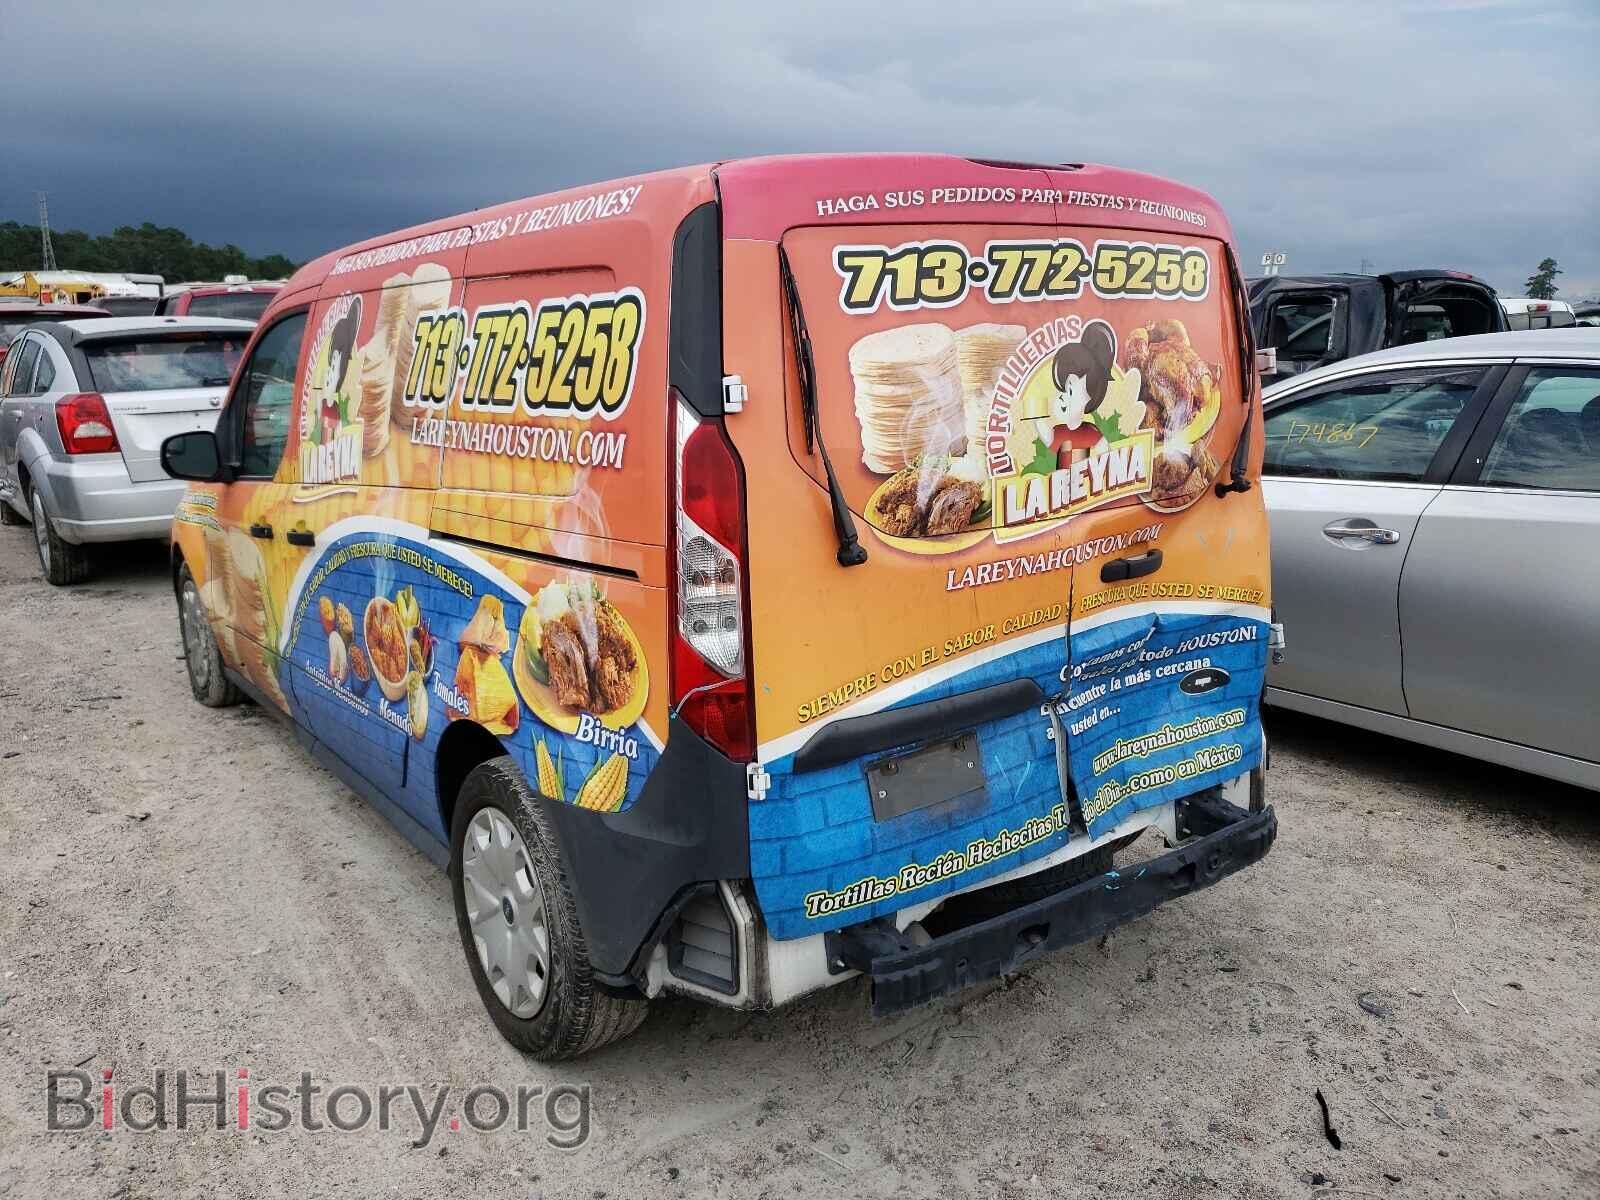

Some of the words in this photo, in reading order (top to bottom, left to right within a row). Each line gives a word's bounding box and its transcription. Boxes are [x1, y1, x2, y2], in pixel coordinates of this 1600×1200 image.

[509, 212, 528, 237] Y
[523, 184, 643, 234] REUNIONES!
[816, 195, 880, 216] HAGA
[885, 190, 925, 207] SUS
[931, 187, 1016, 204] PEDIDOS
[1020, 188, 1063, 204] PARA
[1067, 190, 1124, 210] FIESTAS
[1128, 197, 1138, 211] Y
[1138, 199, 1207, 228] REUNIONES!
[986, 316, 1082, 476] TORTILLERIAS
[410, 417, 626, 469] LAREYNAHOUSTON.COM
[1005, 476, 1047, 526] LA
[1050, 442, 1147, 511] REYNA
[382, 543, 397, 560] QUE
[397, 545, 422, 568] USTED
[422, 555, 434, 574] SE
[433, 562, 474, 600] MERECE!
[946, 524, 1164, 591] LAREYNAHOUSTON.COM
[798, 672, 877, 723] SIEMPRE
[880, 655, 917, 683] CON
[920, 644, 939, 668] EL
[943, 624, 998, 657] SABOR,
[1001, 604, 1062, 635] CALIDAD
[1079, 585, 1127, 613] FRESCURA
[1128, 583, 1149, 602] QUE
[1150, 583, 1194, 598] USTED
[1197, 583, 1215, 600] SE
[1217, 584, 1264, 605] MERECE!
[1060, 648, 1125, 682] Coamos
[1139, 648, 1173, 663] todo
[1177, 626, 1257, 653] HOUSTON!
[433, 671, 470, 715] Tamales
[1110, 676, 1121, 692] la
[1125, 667, 1151, 687] más
[1155, 657, 1211, 678] cercana
[379, 697, 413, 736] Menudo
[575, 713, 639, 759] Birria
[1070, 708, 1098, 736] usted
[806, 876, 897, 917] Tortillas
[899, 851, 965, 891] Recién
[966, 817, 1053, 867] Hechecitas
[1094, 788, 1105, 815] el
[1178, 760, 1197, 779] en
[1196, 744, 1243, 773] México
